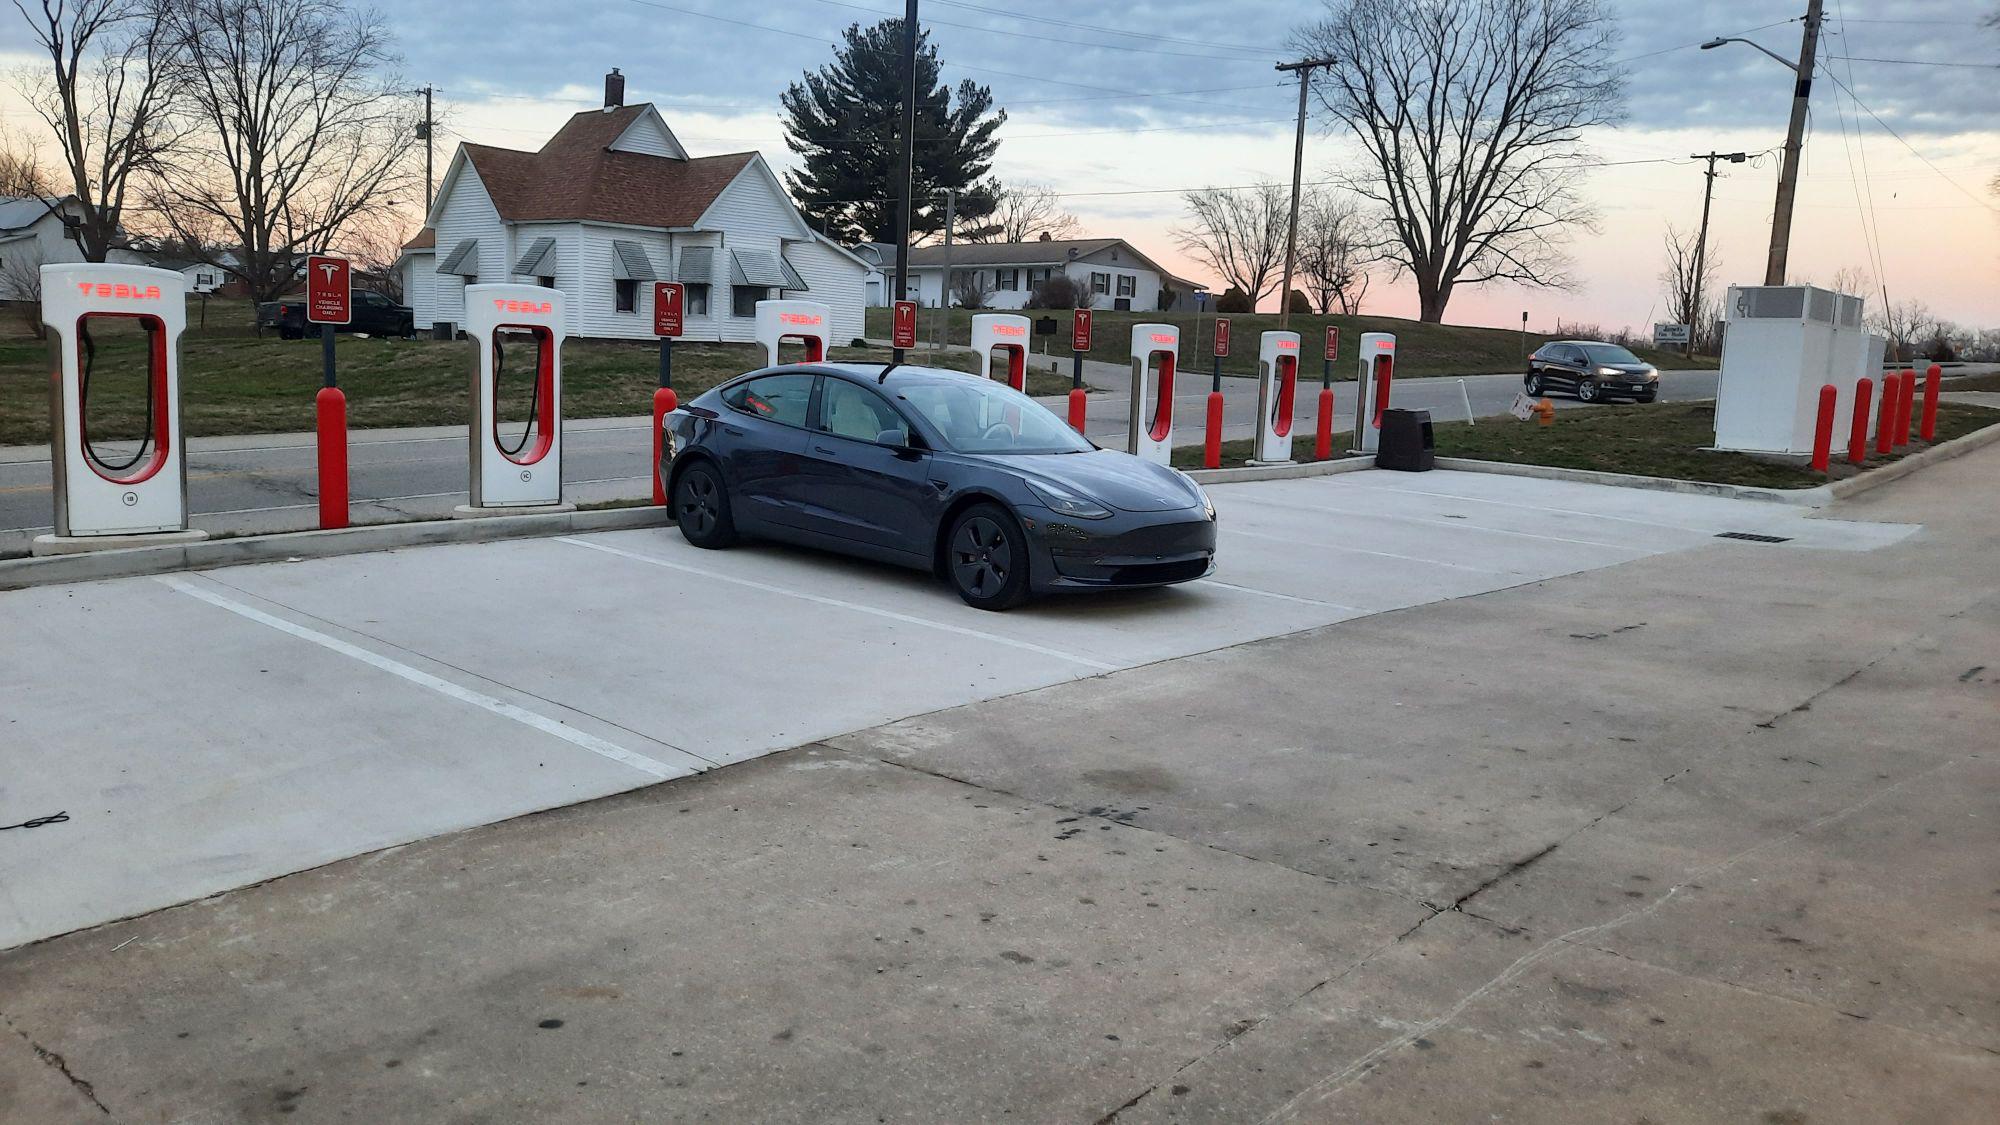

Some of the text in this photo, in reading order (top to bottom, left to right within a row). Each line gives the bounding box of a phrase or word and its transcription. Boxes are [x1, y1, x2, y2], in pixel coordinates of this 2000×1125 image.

[77, 282, 161, 299] TESLA
[494, 300, 552, 313] TESLA
[780, 313, 822, 325] TESLA
[992, 324, 1025, 336] TESLA
